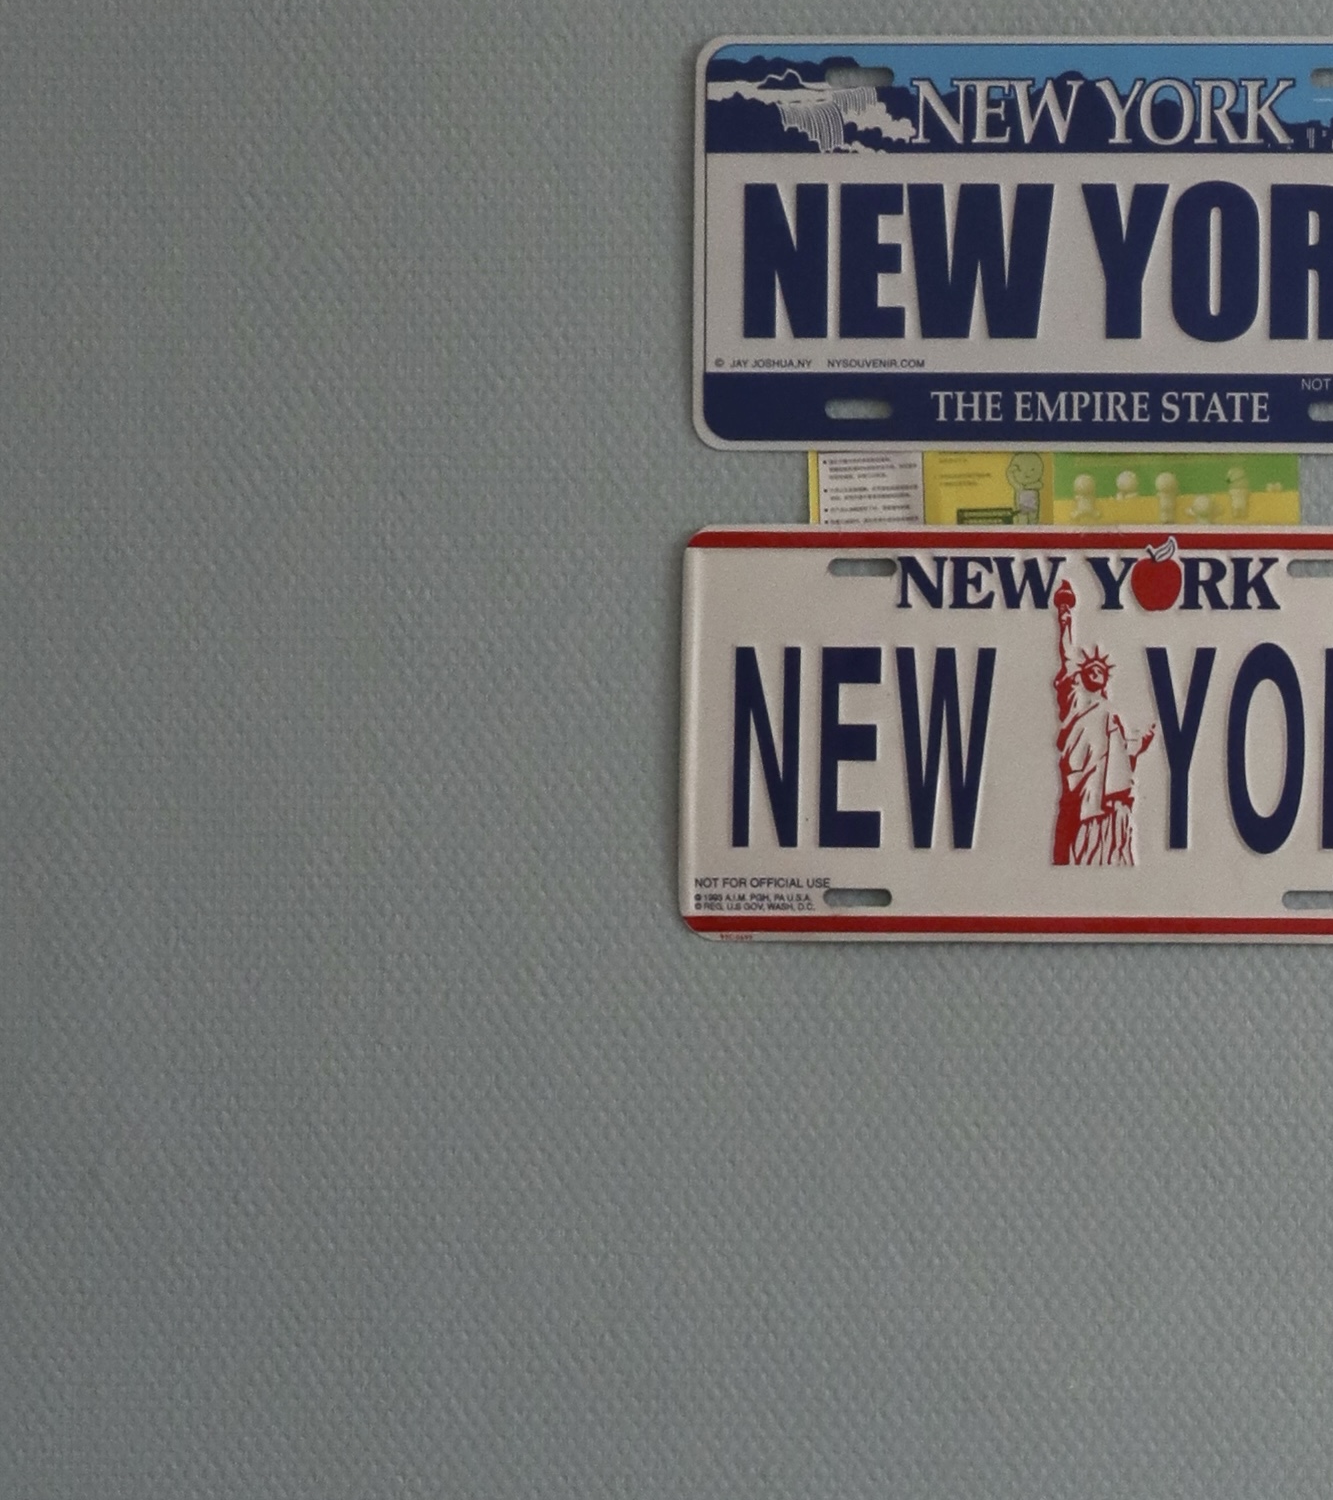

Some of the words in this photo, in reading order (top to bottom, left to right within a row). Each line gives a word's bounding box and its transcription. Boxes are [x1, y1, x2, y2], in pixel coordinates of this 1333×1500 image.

[910, 76, 1081, 145] NEW
[1094, 75, 1295, 146] YORK
[743, 183, 1054, 340] NEW
[730, 359, 748, 368] JAY
[1301, 378, 1331, 391] NOT
[930, 391, 1007, 424] THE
[1014, 390, 1151, 425] EMPIRE
[1159, 391, 1270, 425] STATE
[895, 555, 1063, 610] NEW
[732, 646, 996, 849] NEW
[694, 878, 719, 888] NOT
[722, 878, 747, 888] FOR
[750, 878, 803, 888] OFFICIAL
[807, 878, 831, 888] USE
